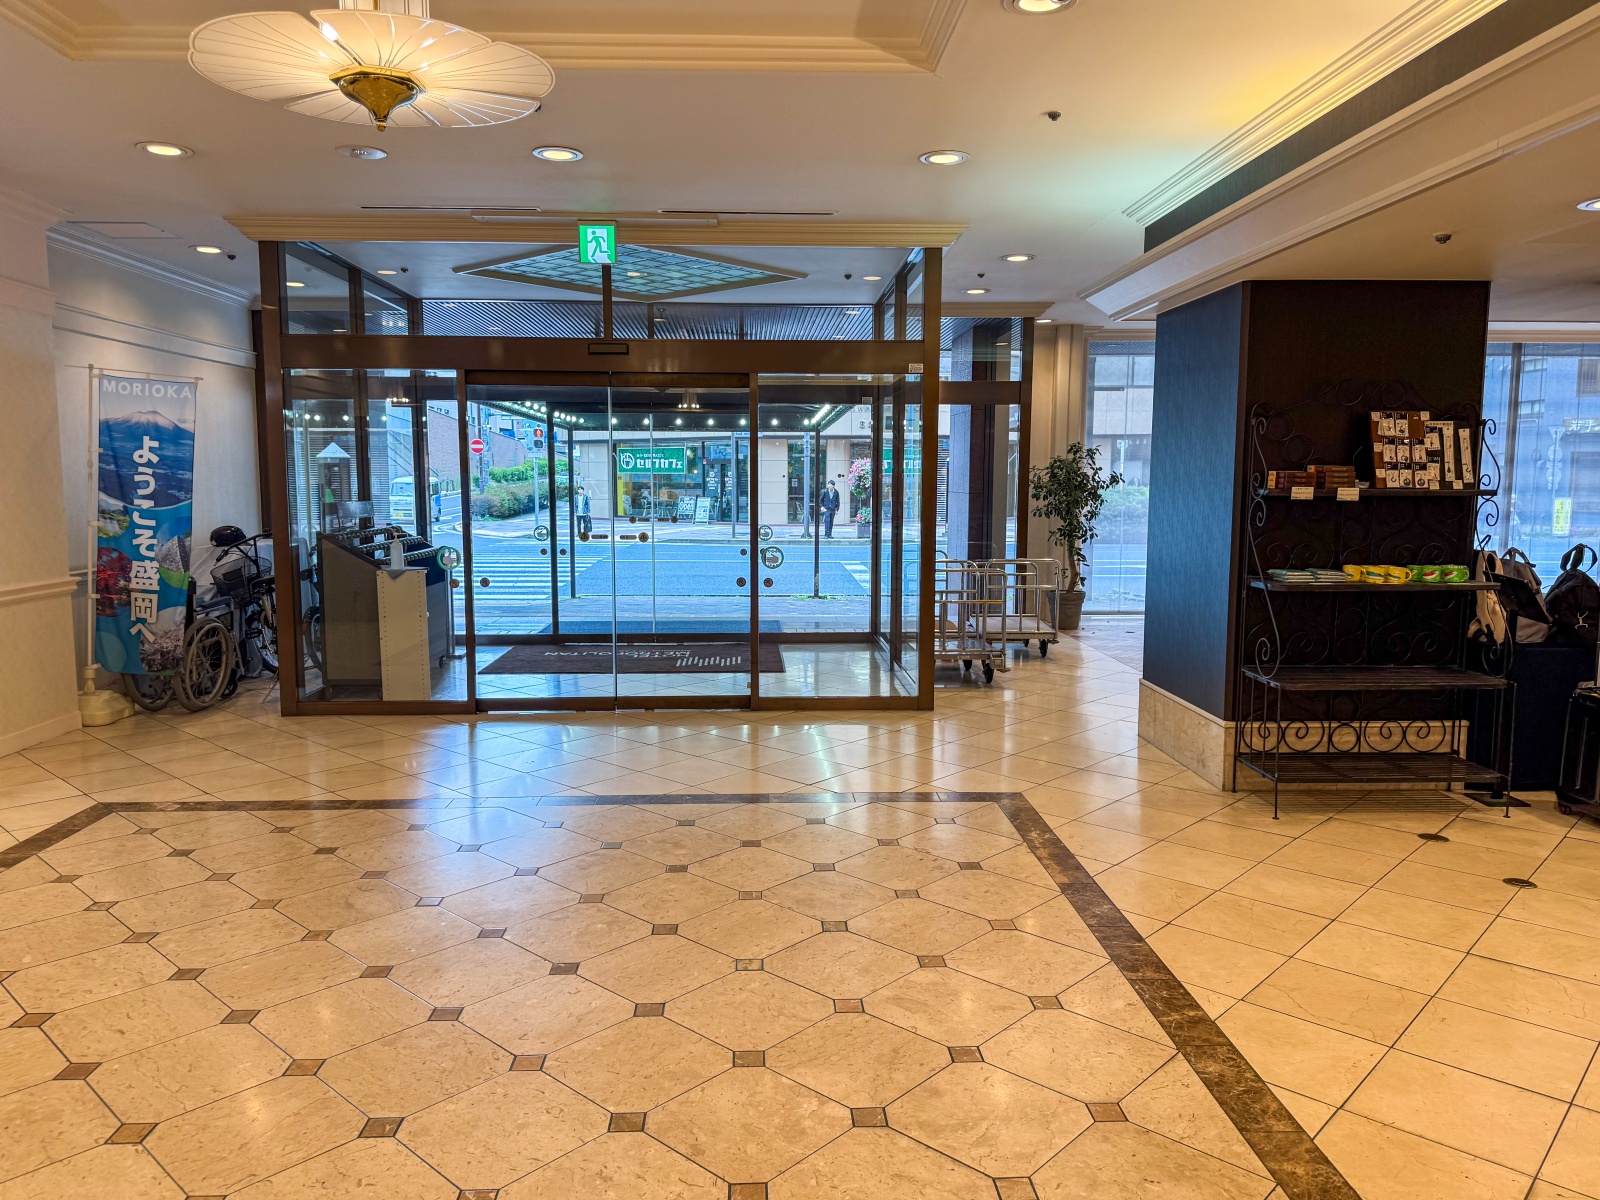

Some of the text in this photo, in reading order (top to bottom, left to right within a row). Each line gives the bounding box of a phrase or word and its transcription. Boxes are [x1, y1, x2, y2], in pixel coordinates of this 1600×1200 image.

[102, 379, 192, 399] MORIOKA
[1569, 418, 1600, 433] 岩手
[129, 435, 160, 643] ようこそ盛岡へ
